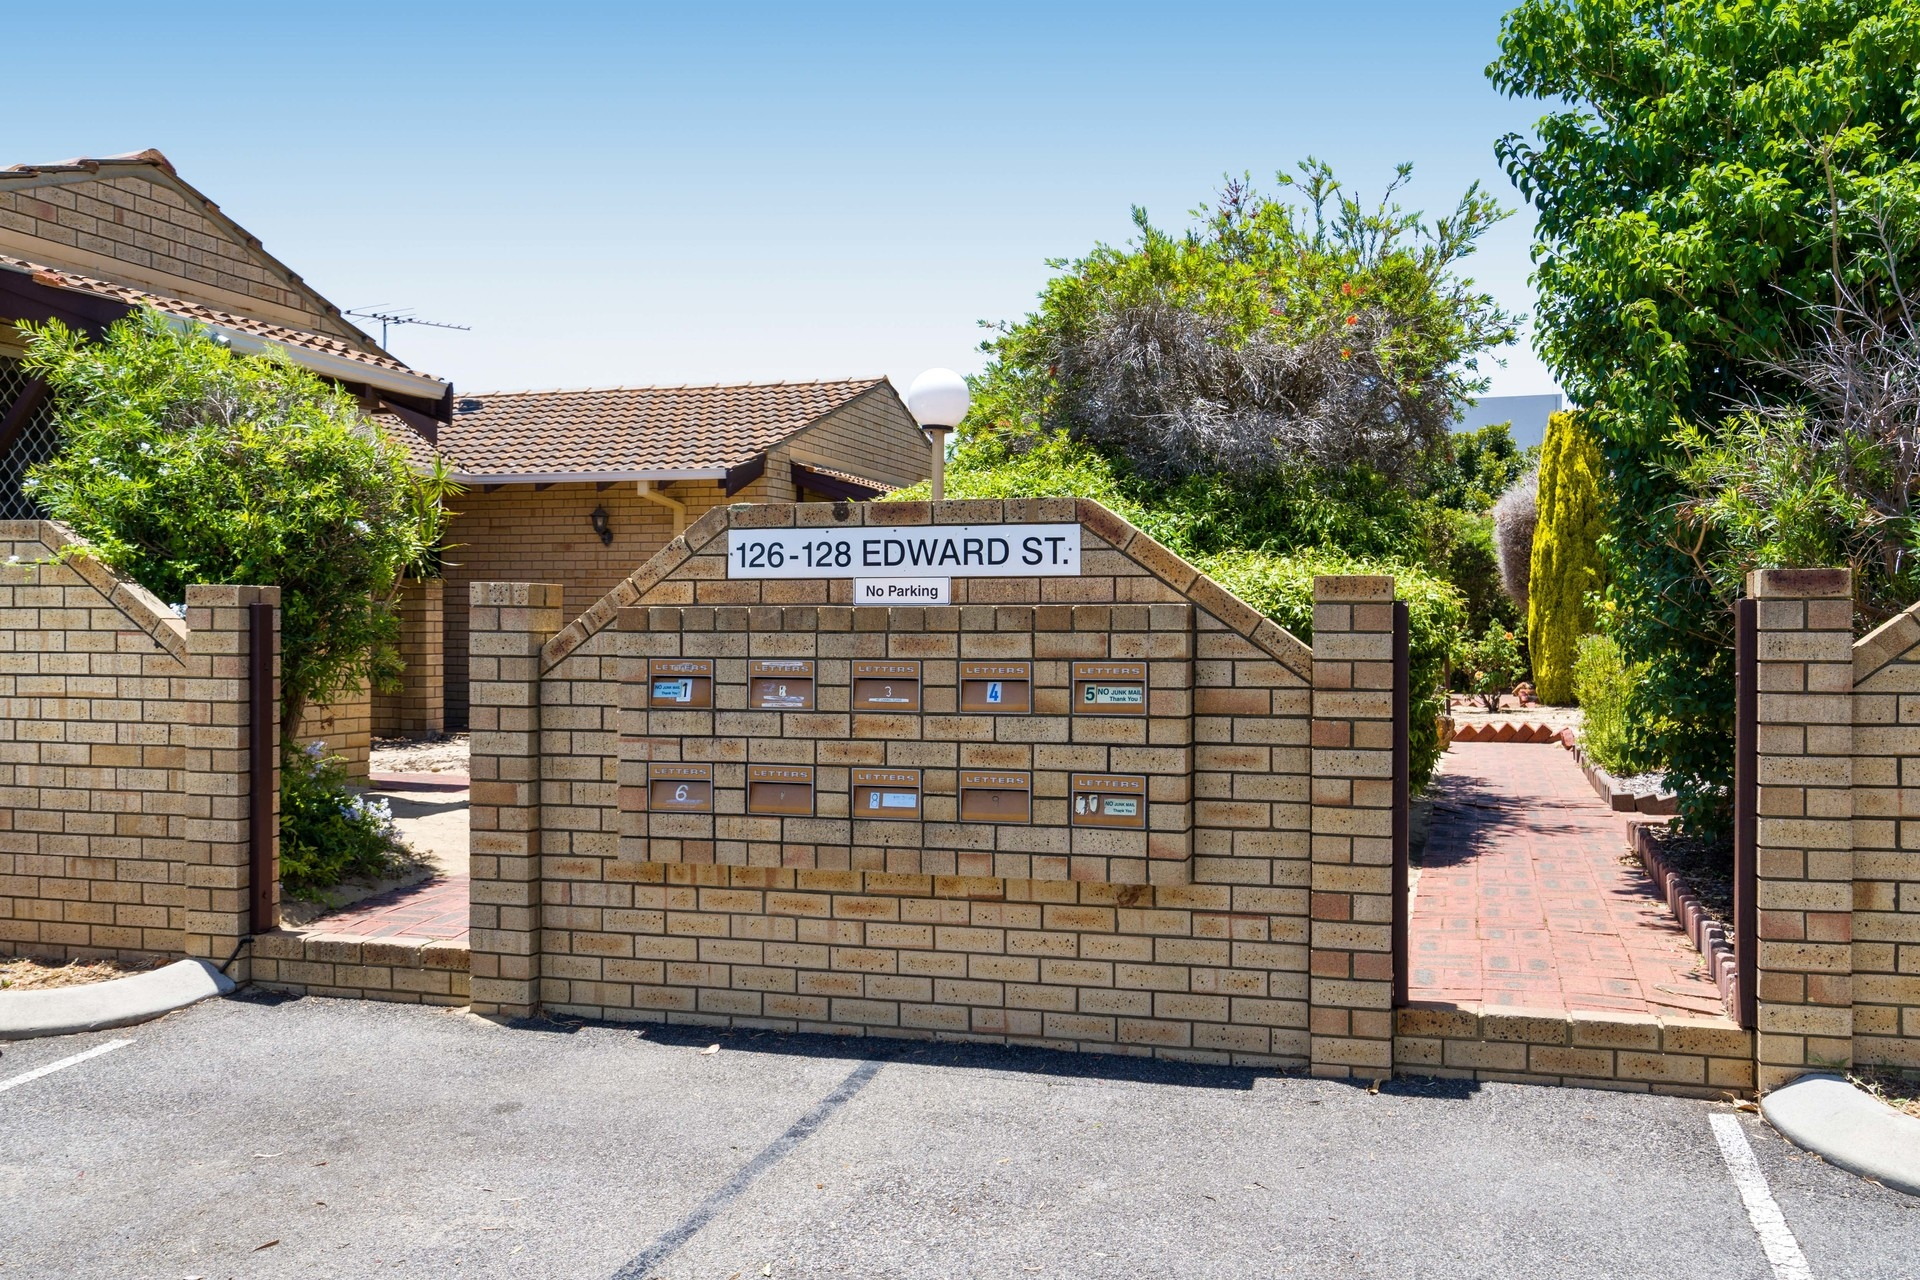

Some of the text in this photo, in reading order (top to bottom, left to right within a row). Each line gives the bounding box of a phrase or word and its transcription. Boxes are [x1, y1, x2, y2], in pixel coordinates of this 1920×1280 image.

[862, 538, 1010, 567] EDWARD
[1021, 536, 1069, 566] ST.
[866, 584, 938, 599] No Parking
[754, 665, 809, 673] LETTERS
[1080, 667, 1140, 675] LETTERS
[682, 682, 688, 698] 1
[884, 685, 892, 698] 3
[989, 683, 999, 701] 4
[1085, 686, 1095, 701] 5
[1097, 688, 1109, 696] NO
[754, 770, 809, 778] LETTERS
[858, 773, 915, 781] LETTERS
[966, 776, 1025, 784] LETTERS
[1079, 779, 1139, 788] LETTERS
[675, 784, 689, 801] 6
